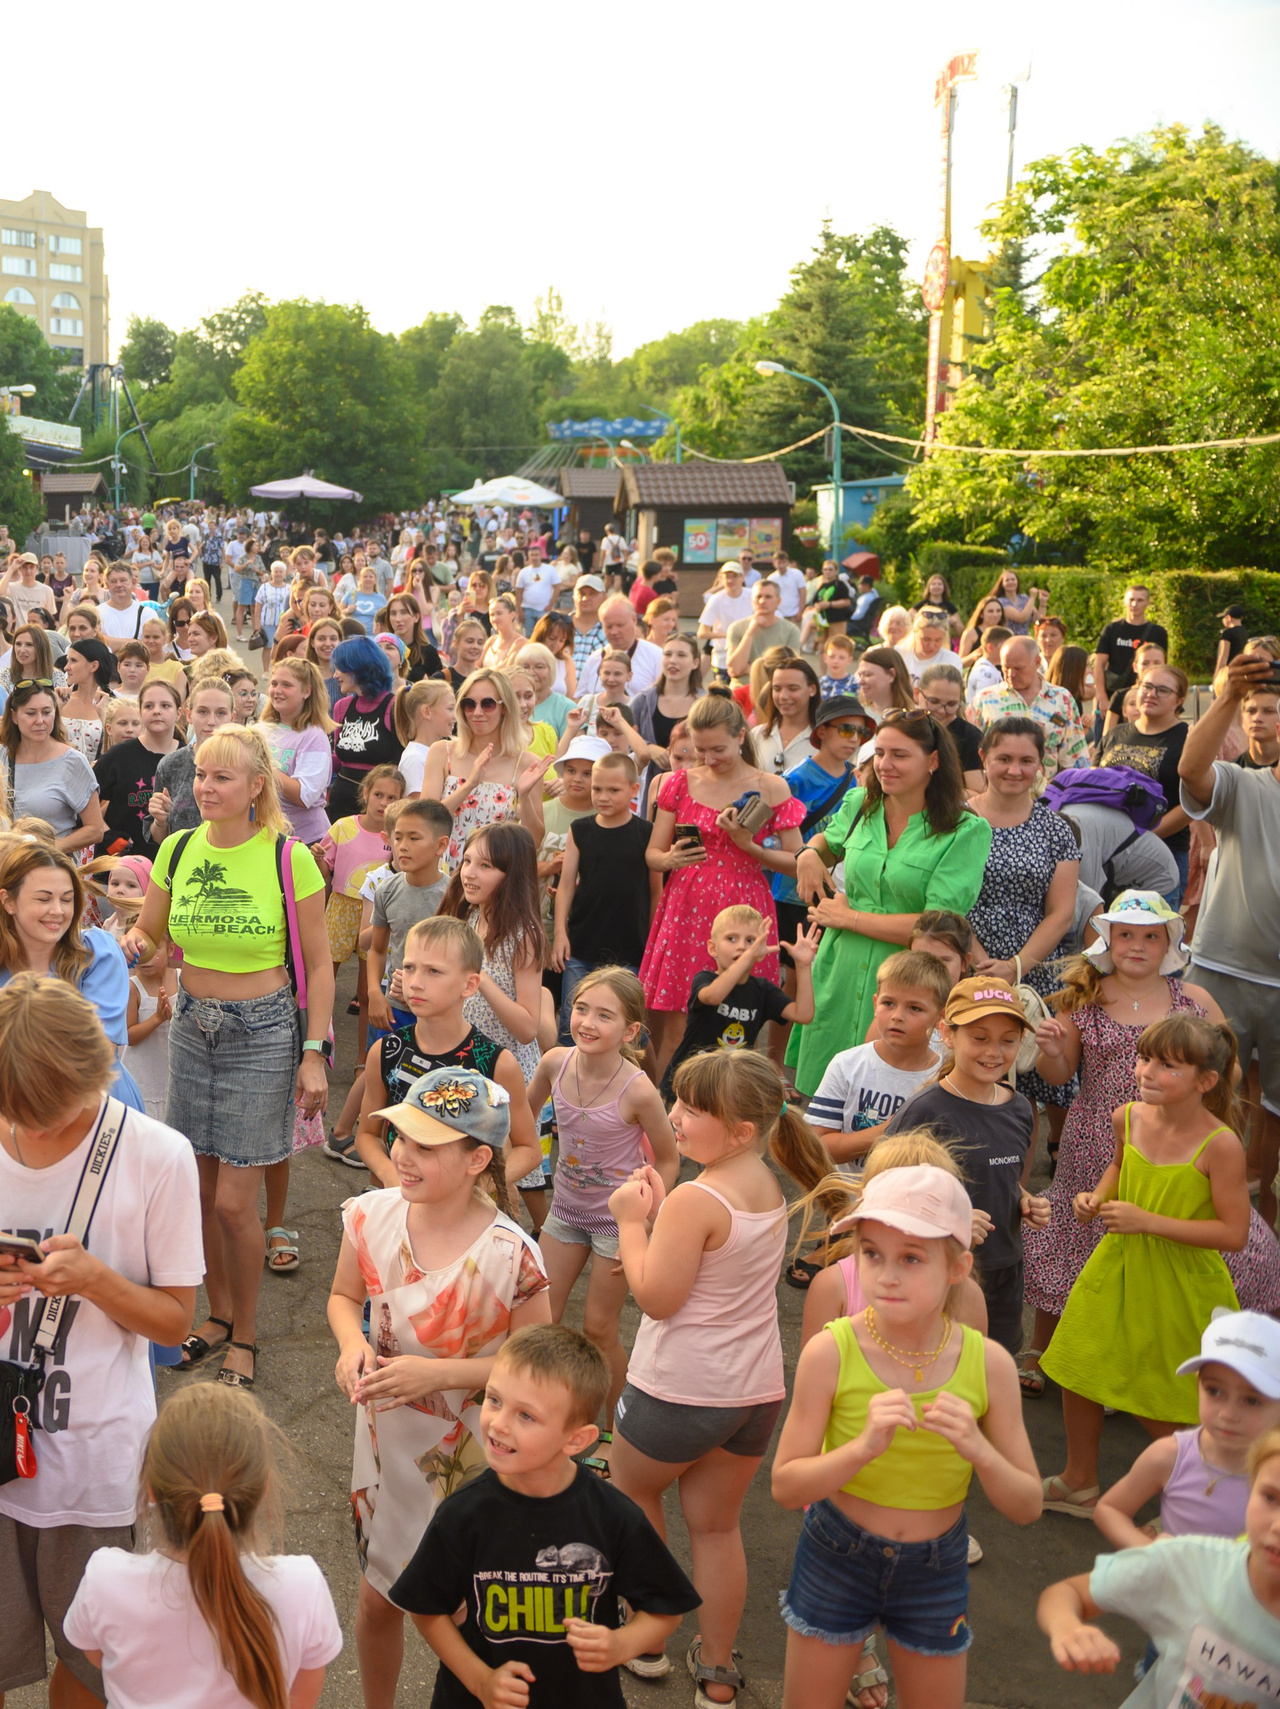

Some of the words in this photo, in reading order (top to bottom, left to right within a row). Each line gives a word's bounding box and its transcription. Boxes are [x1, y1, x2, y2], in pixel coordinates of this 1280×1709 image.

[170, 914, 261, 925] HERMOSA
[214, 924, 275, 935] BEACH
[974, 988, 1013, 1003] BUCK
[717, 1003, 757, 1021] BABY
[90, 1131, 112, 1176] DICKIES
[989, 1155, 1020, 1166] MONOKIDS
[45, 1295, 62, 1323] DICK
[17, 1433, 25, 1455] NIKE
[480, 1571, 503, 1581] BREAK
[505, 1572, 518, 1582] THE
[553, 1573, 567, 1584] IT'S
[569, 1574, 585, 1583] TIME
[1201, 1641, 1280, 1699] HAWA
